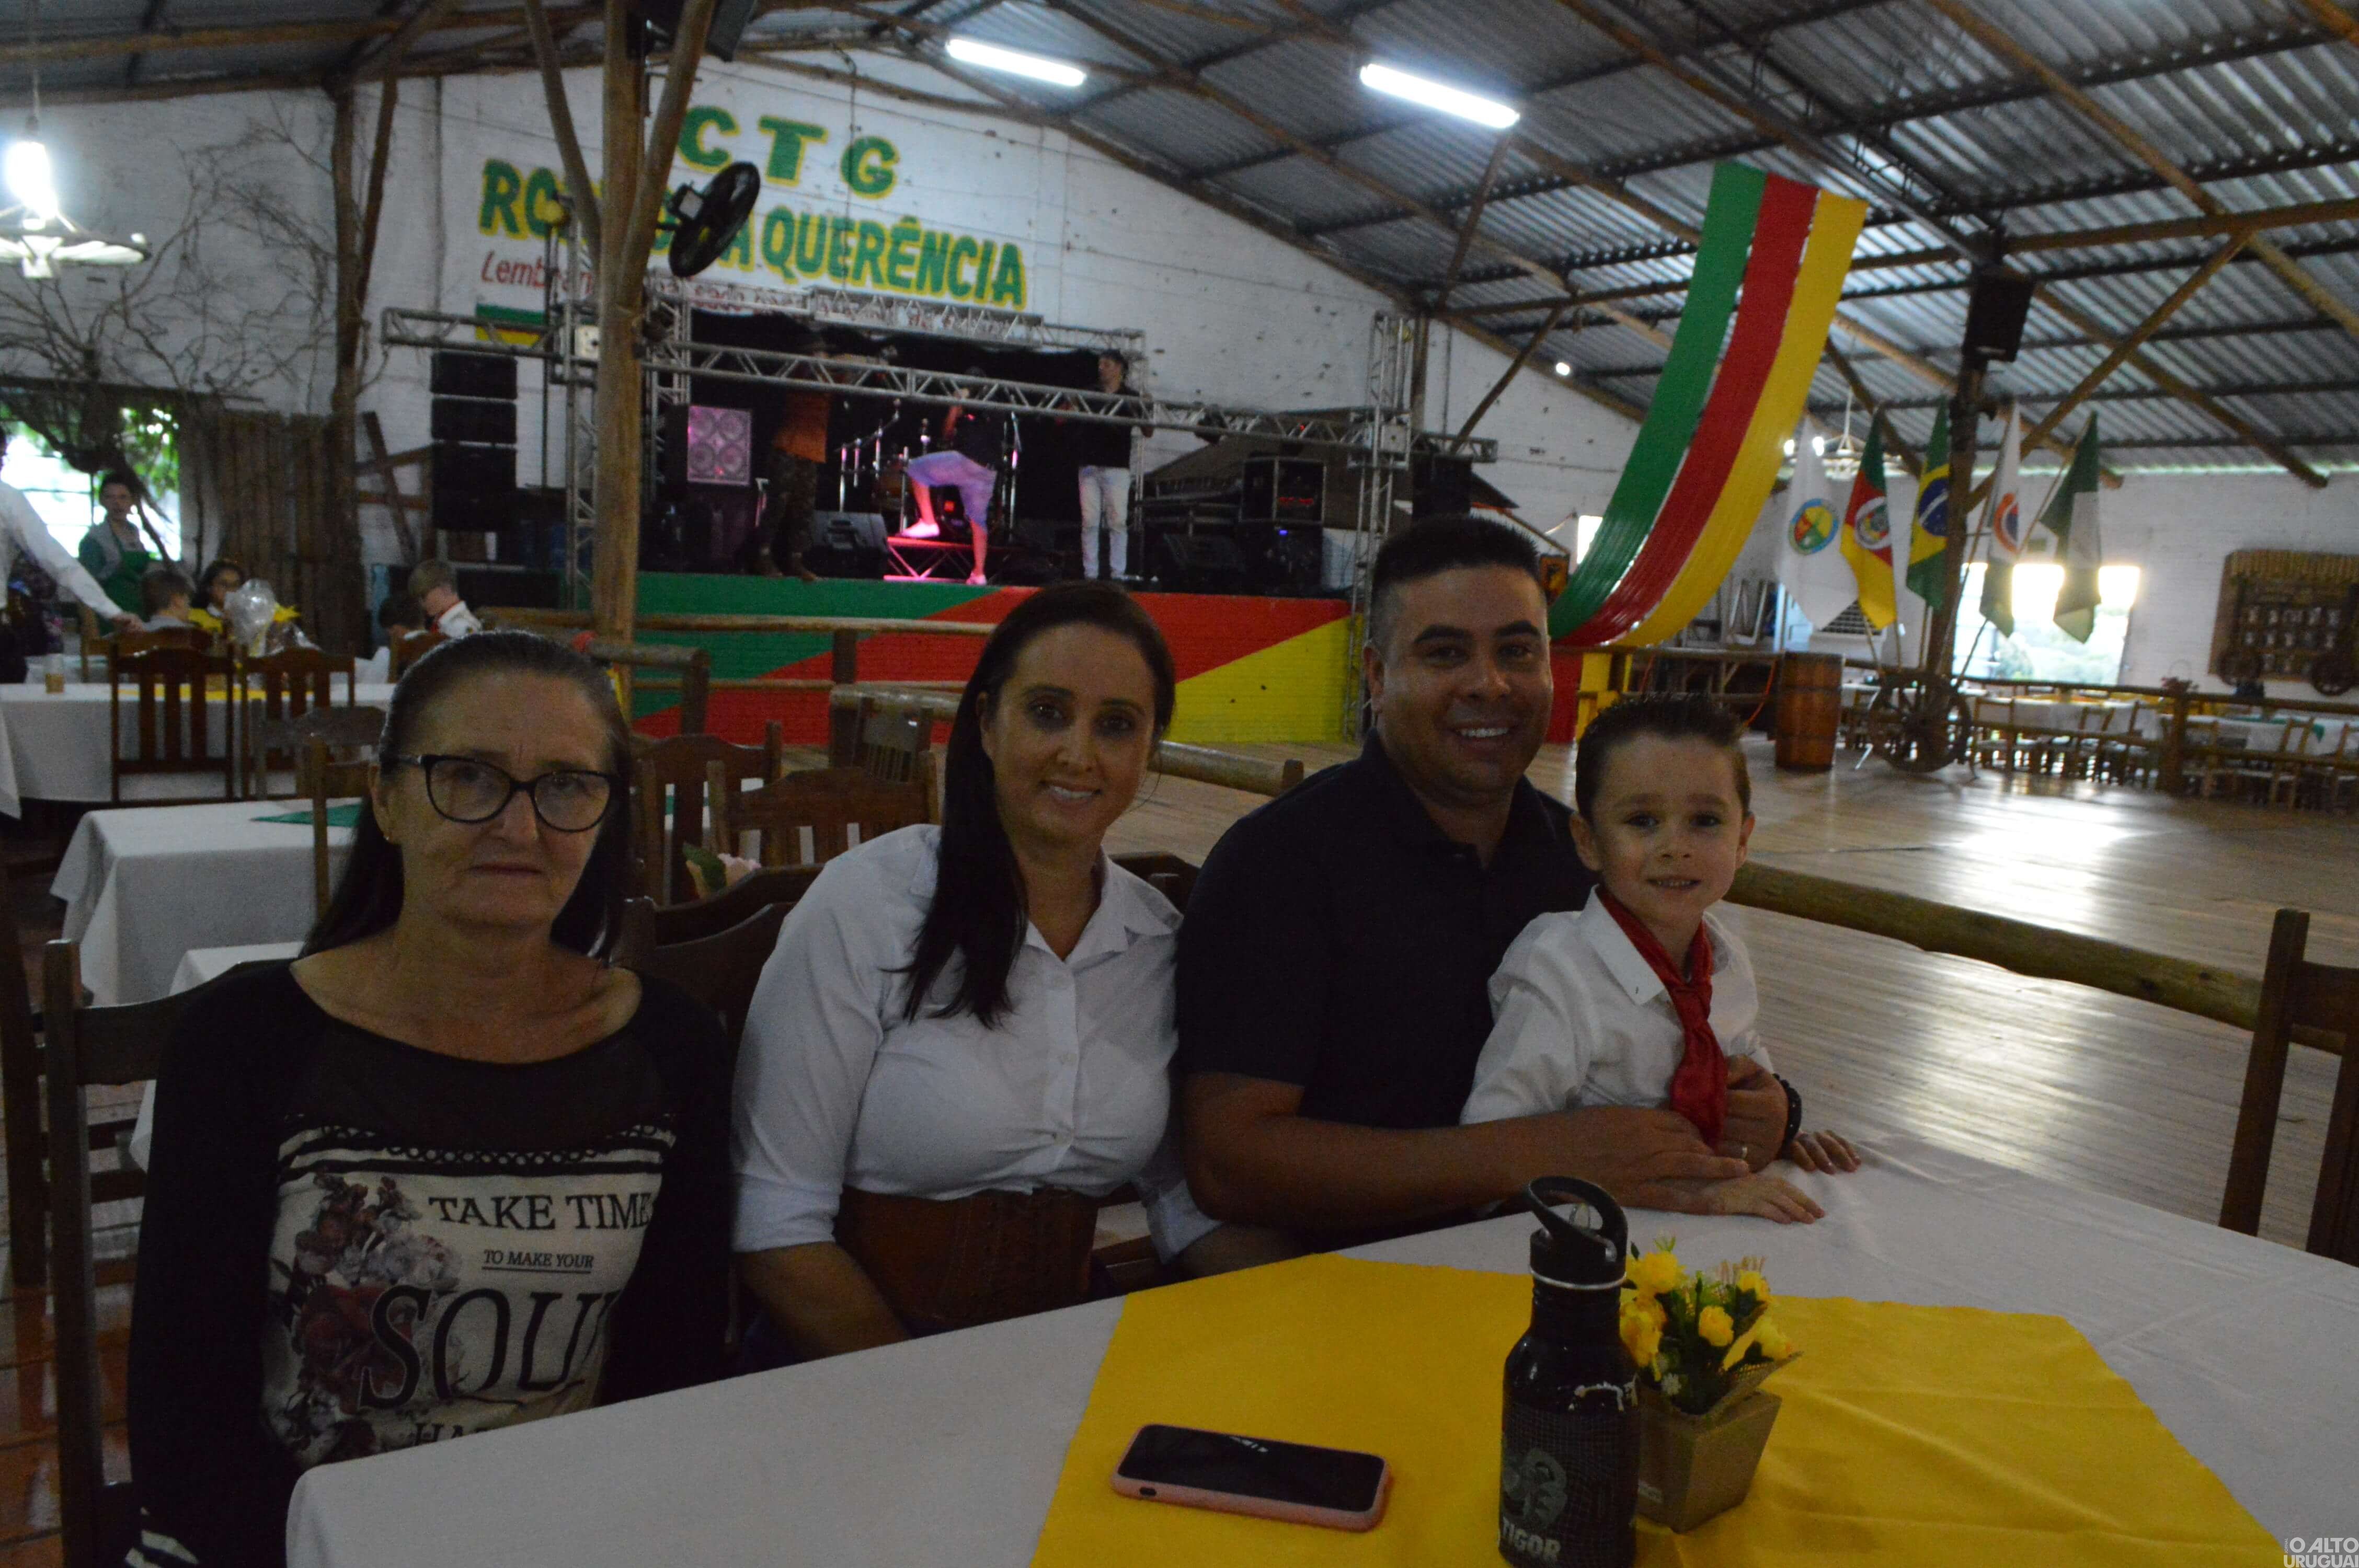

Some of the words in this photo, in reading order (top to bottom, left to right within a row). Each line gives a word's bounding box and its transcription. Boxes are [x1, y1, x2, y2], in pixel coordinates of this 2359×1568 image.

[678, 106, 900, 200] CTG
[761, 205, 1026, 310] QUERÊNCIA
[428, 1195, 555, 1230] TAKE
[565, 1192, 655, 1230] TIME
[484, 1250, 503, 1265] TO
[507, 1251, 552, 1267] MAKE
[555, 1254, 595, 1269] YOUR
[1501, 1515, 1562, 1563] TIGOR
